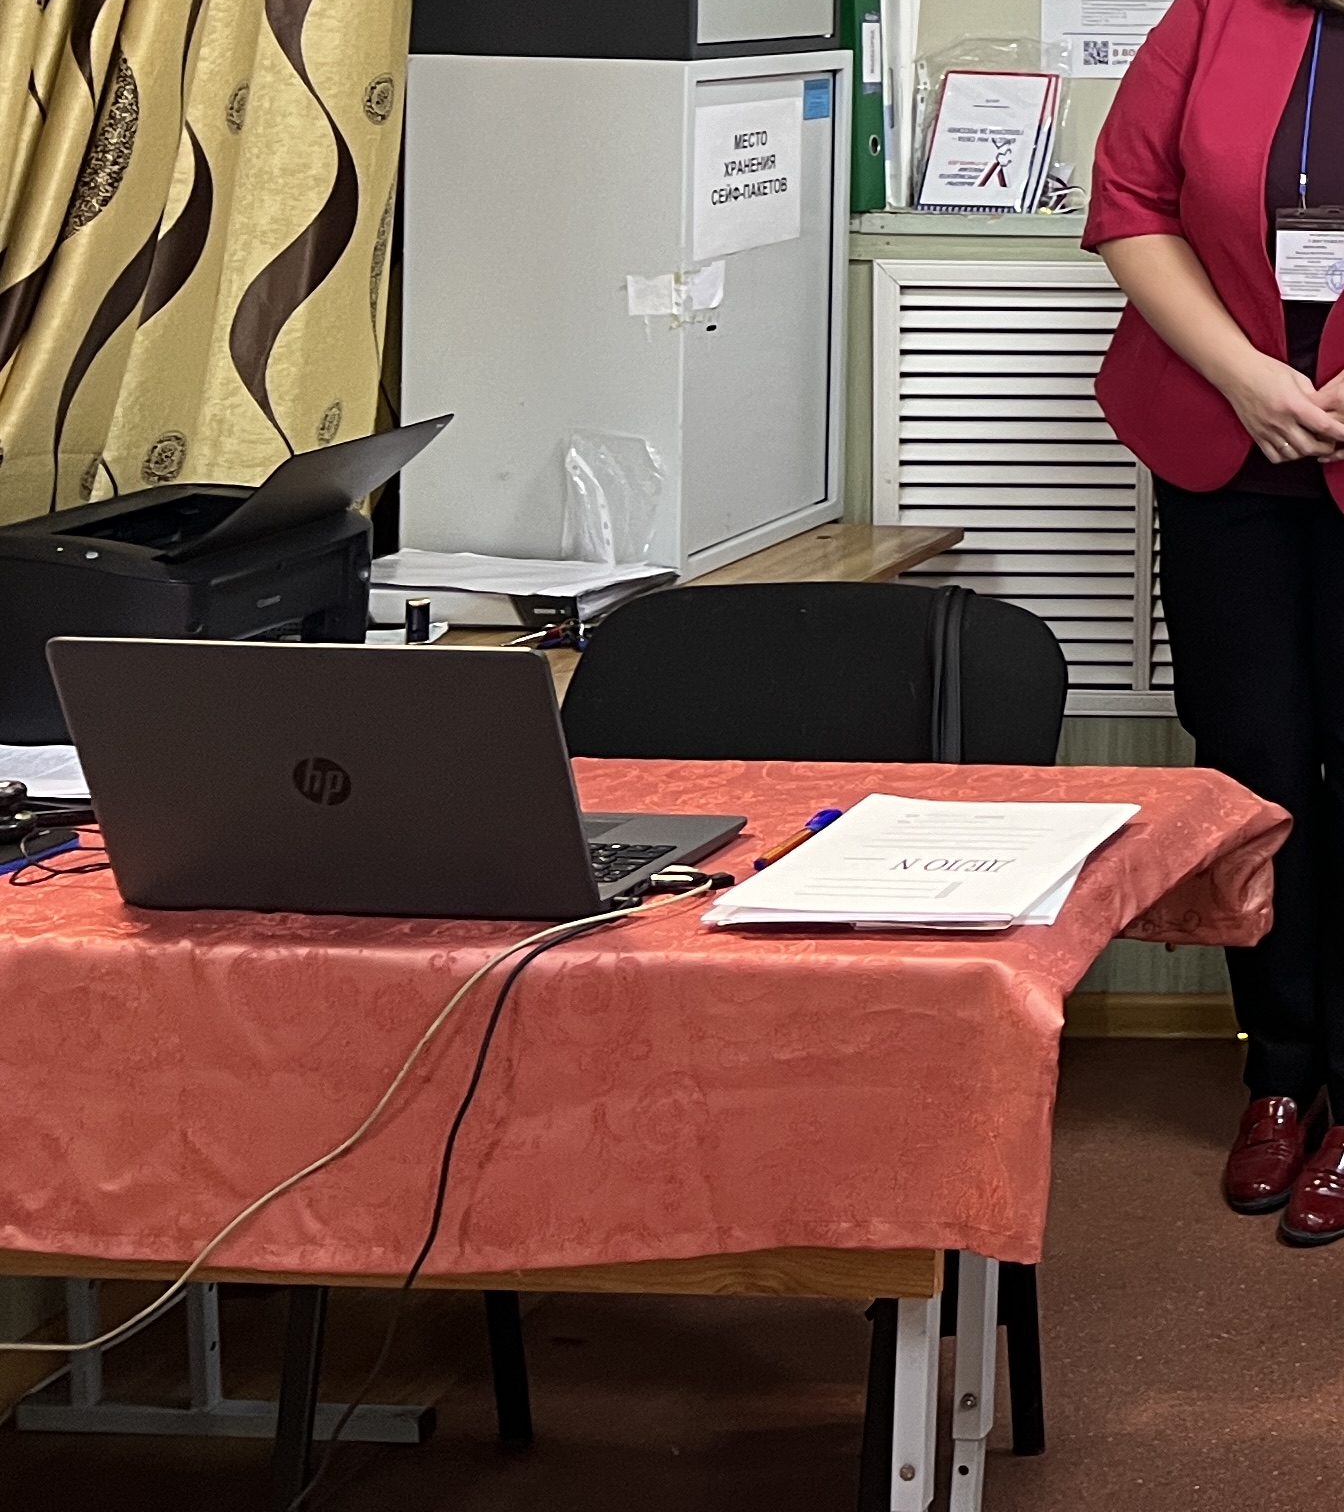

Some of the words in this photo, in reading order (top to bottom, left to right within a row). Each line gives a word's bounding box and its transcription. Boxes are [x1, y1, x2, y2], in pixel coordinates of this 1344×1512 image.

[734, 130, 768, 150] МЕСТО
[723, 154, 777, 178] ХРАНЕНИЯ
[711, 177, 788, 206] СЕЙФ-ПАКЕТОВ
[296, 756, 349, 805] hp
